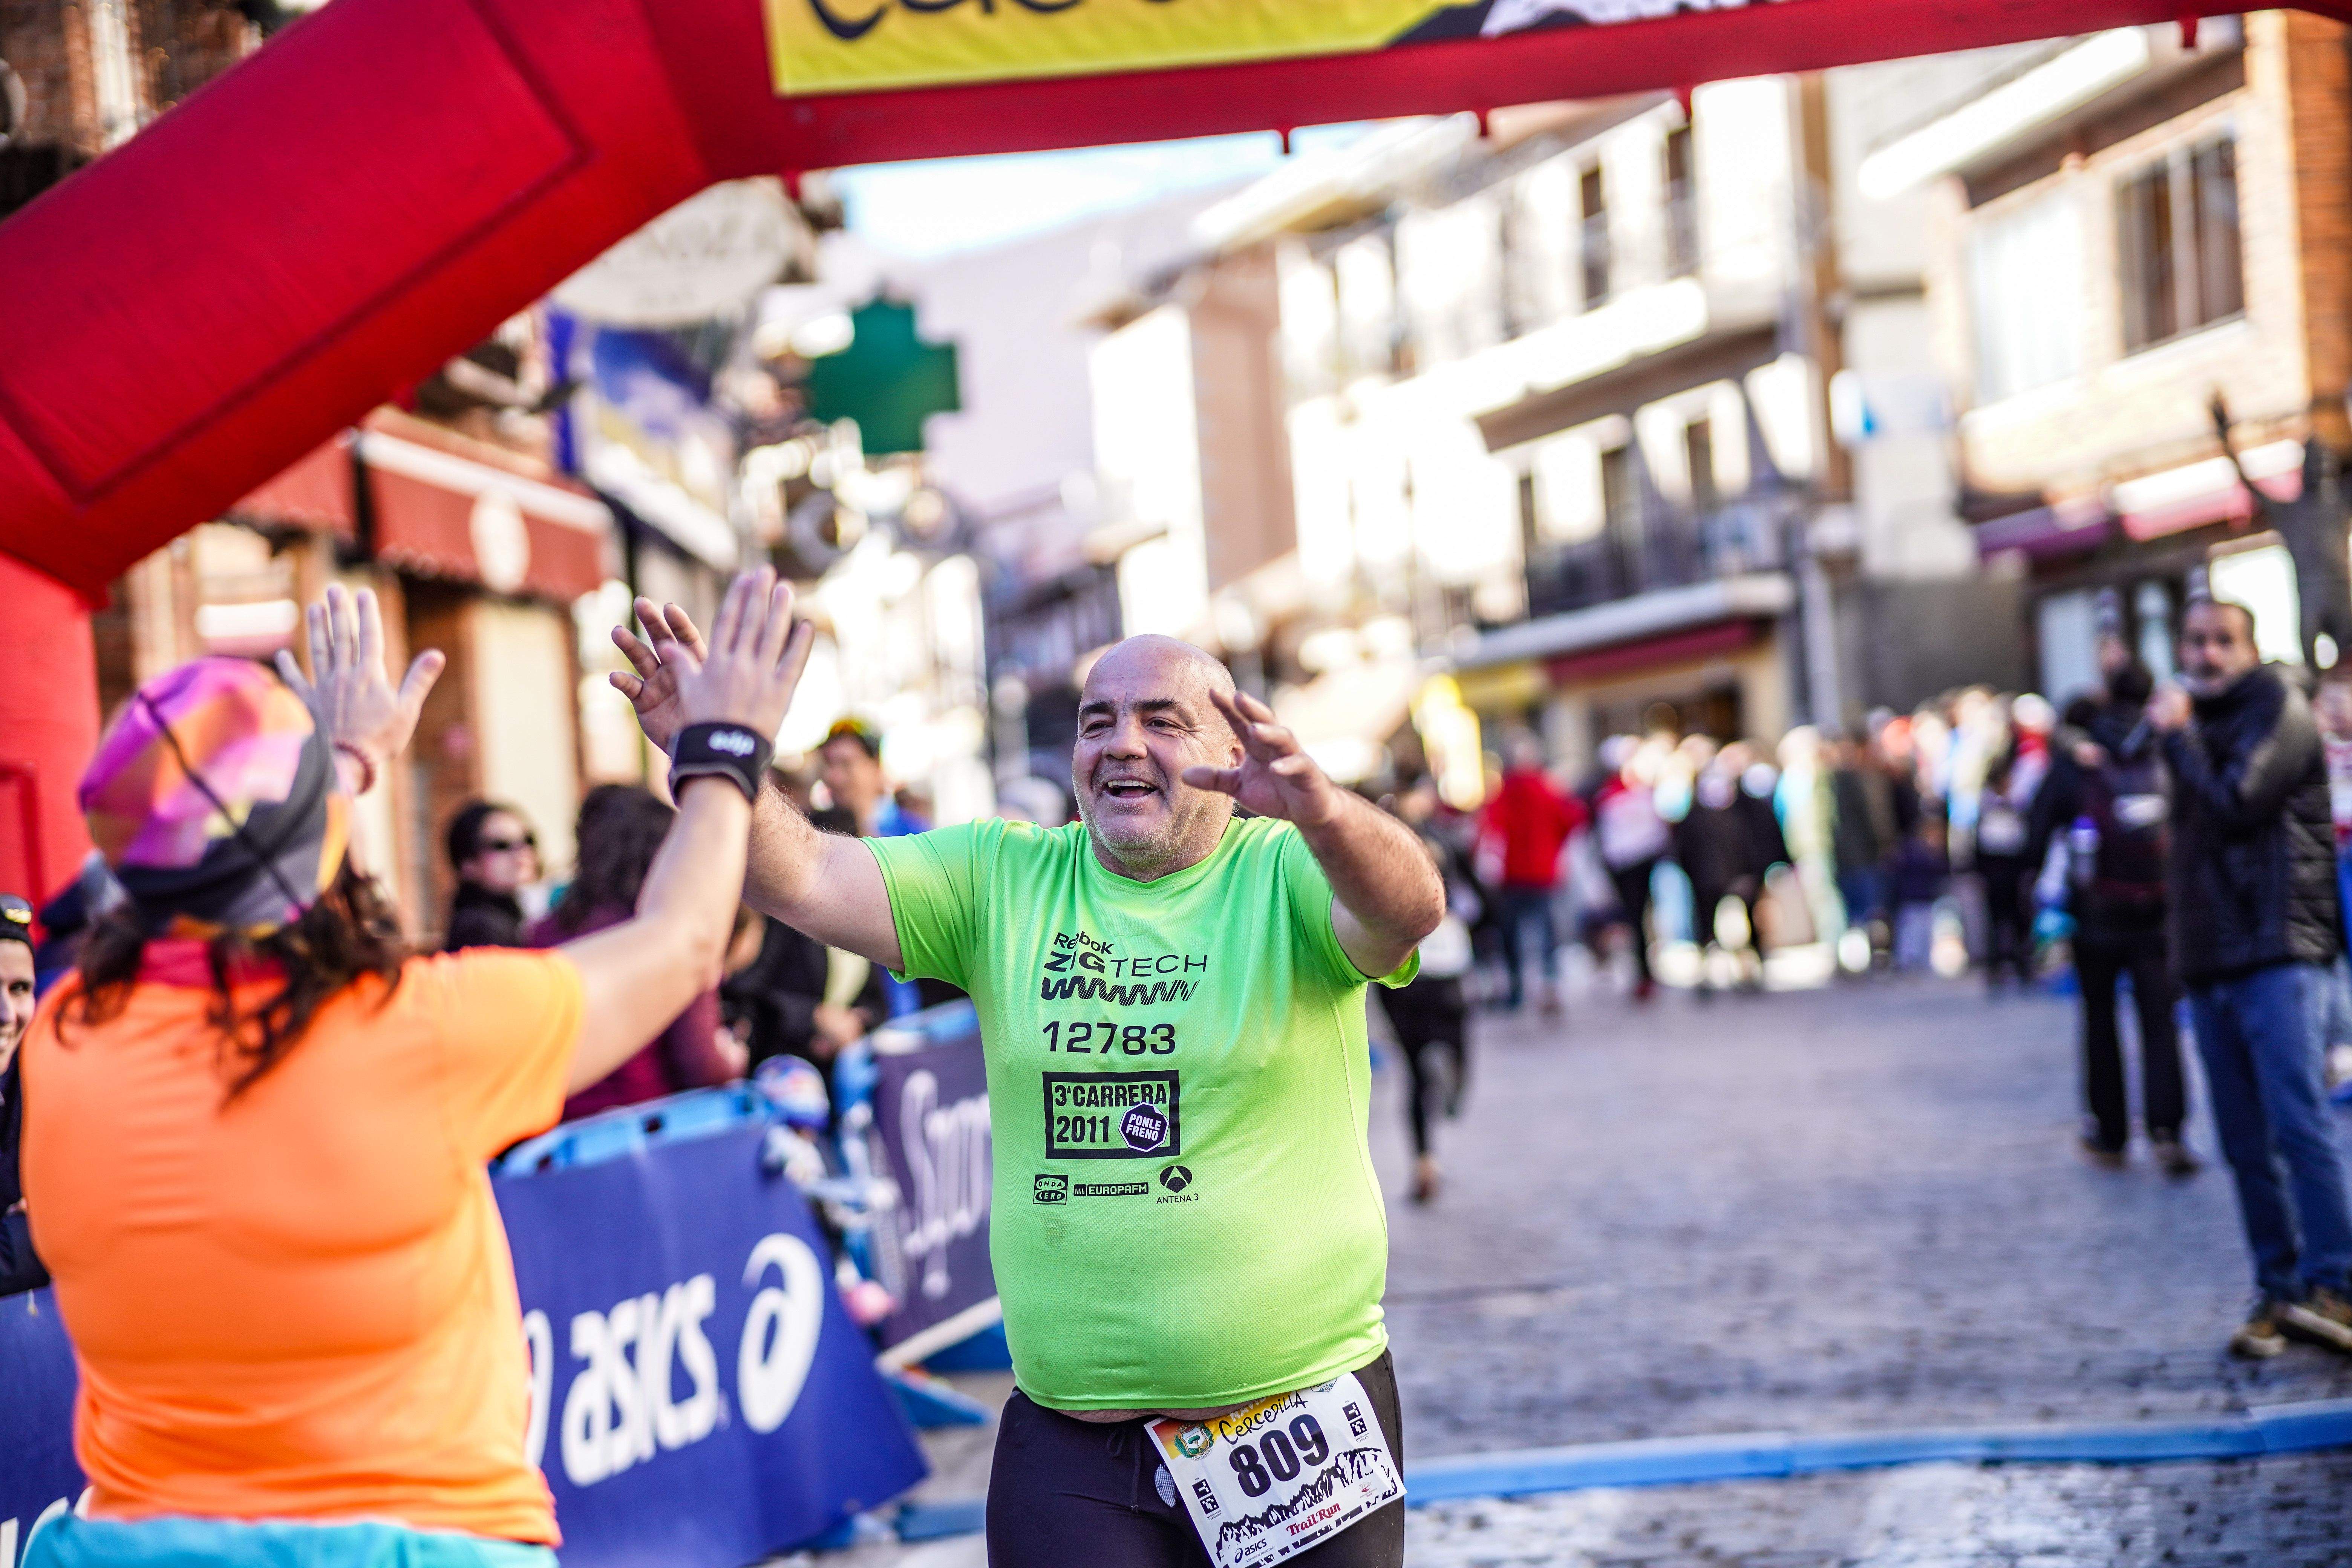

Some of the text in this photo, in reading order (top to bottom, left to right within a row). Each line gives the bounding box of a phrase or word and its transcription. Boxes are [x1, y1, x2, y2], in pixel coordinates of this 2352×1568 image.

[1042, 1021, 1176, 1055] 12783
[1056, 1116, 1109, 1143] 2011
[1125, 1124, 1159, 1141] FRENO
[1129, 1113, 1162, 1131] PONLE
[1156, 1195, 1192, 1204] ANTENA
[562, 1272, 719, 1487] asics
[1194, 1450, 1211, 1460] Cercedilla
[1229, 1414, 1329, 1497] 809
[1286, 1503, 1341, 1536] Trail Run
[1245, 1538, 1267, 1556] asics
